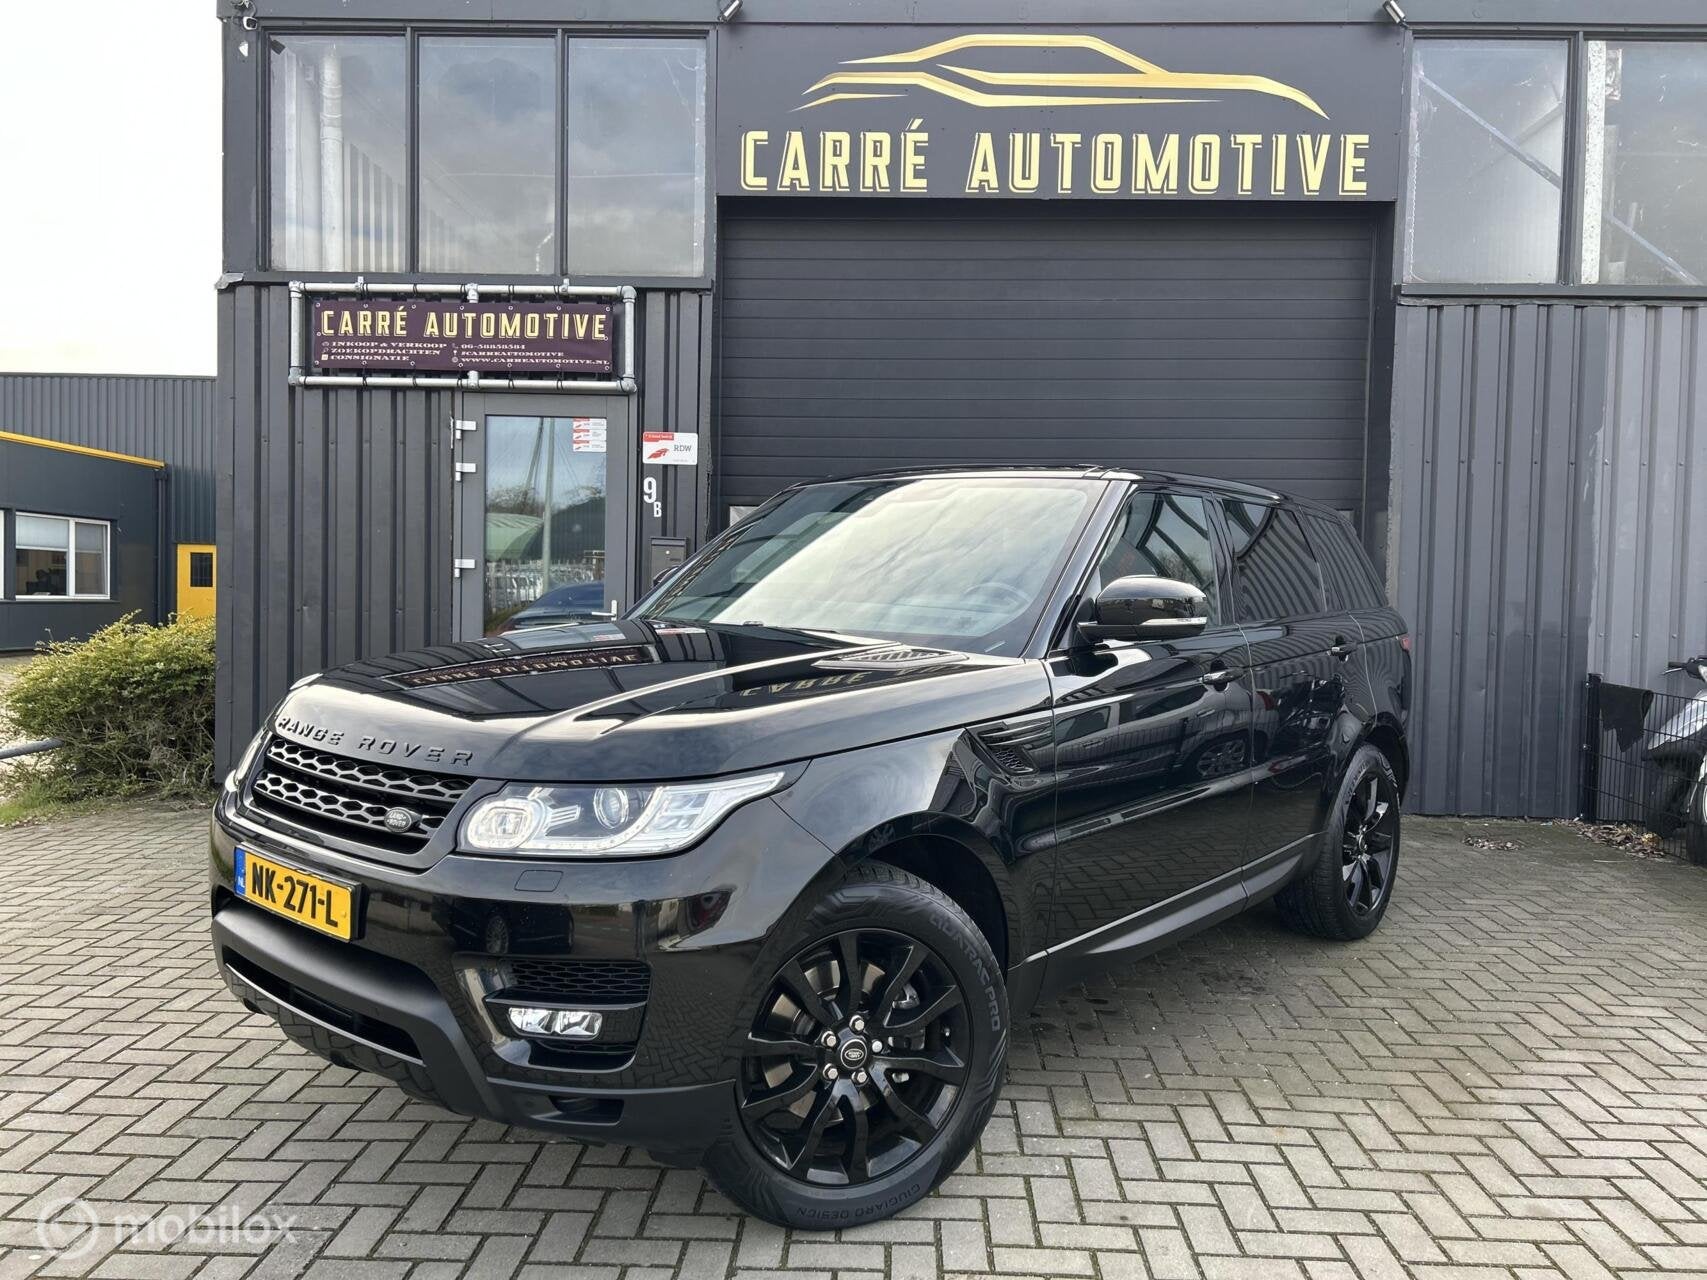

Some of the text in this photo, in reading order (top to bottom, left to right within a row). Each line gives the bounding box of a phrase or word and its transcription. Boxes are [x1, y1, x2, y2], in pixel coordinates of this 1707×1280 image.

[741, 118, 1370, 196] CARRÉ AUTOMOTIVE
[321, 305, 607, 341] CARRÉ AUTOMOTIVE
[673, 444, 692, 452] RDW
[643, 477, 657, 503] 9
[653, 501, 662, 517] B
[277, 716, 474, 767] RANGE ROVER
[251, 861, 339, 928] NK-271-L
[984, 985, 1001, 1032] PRO
